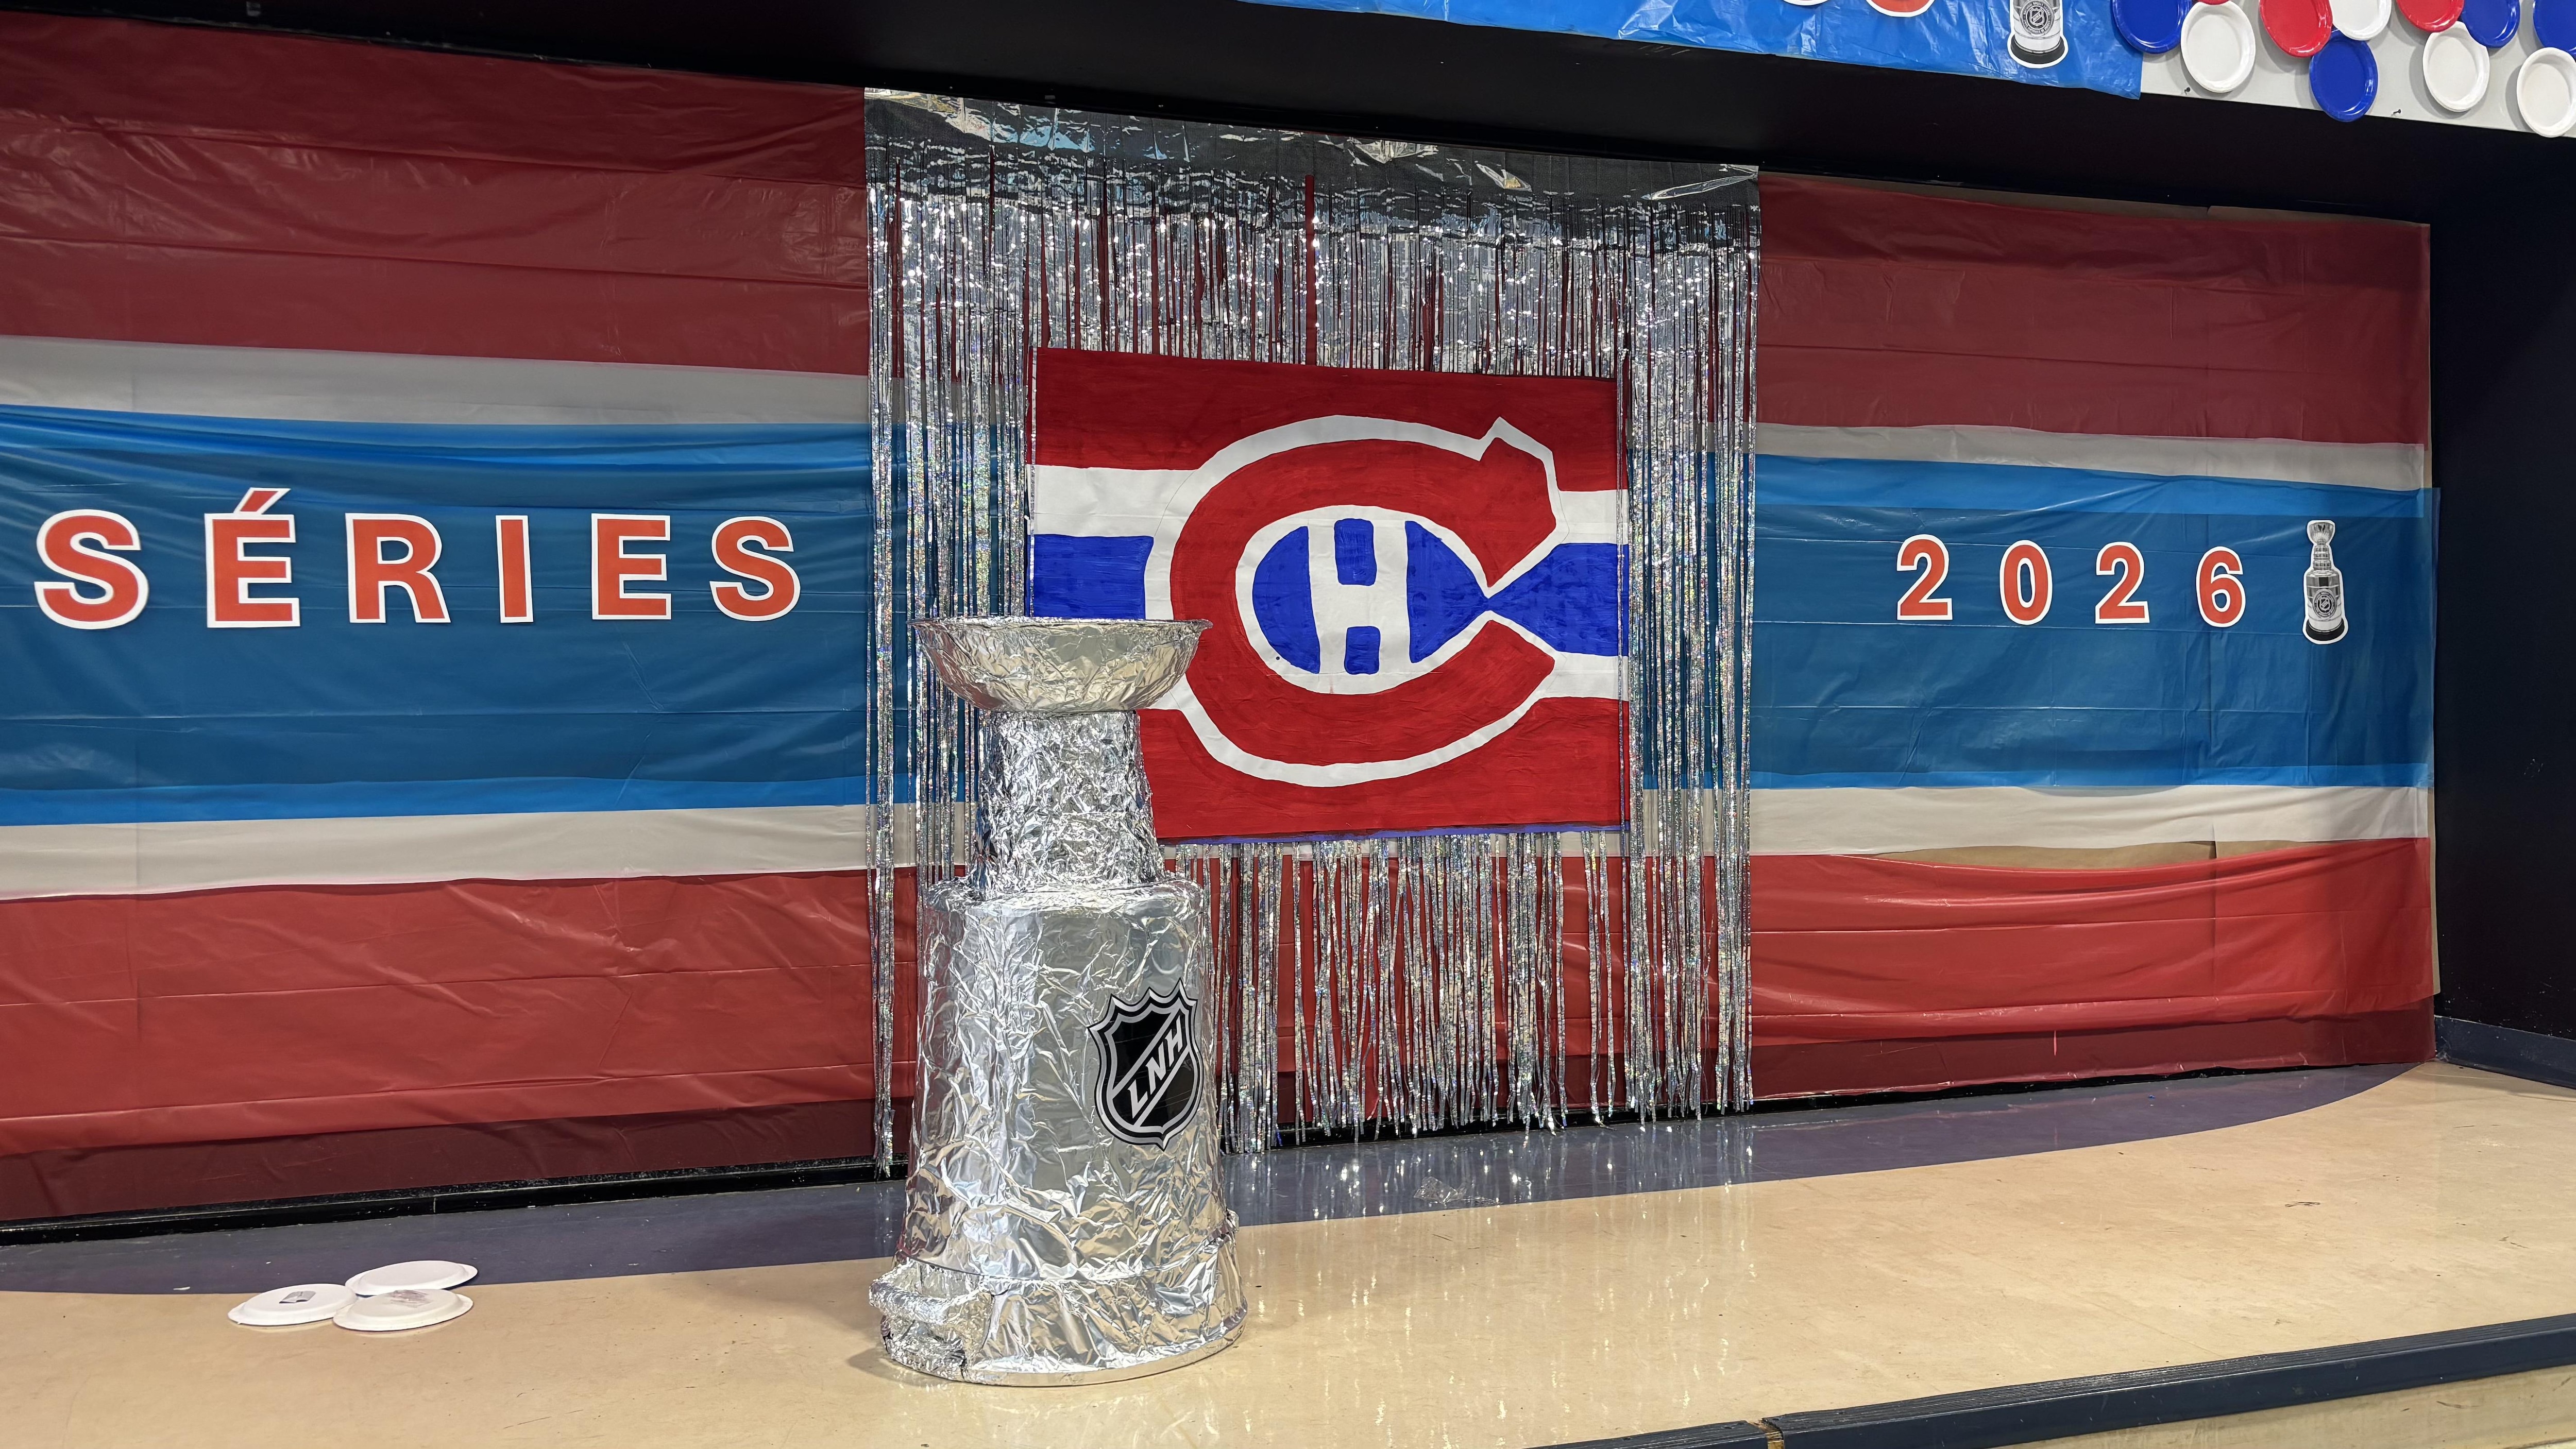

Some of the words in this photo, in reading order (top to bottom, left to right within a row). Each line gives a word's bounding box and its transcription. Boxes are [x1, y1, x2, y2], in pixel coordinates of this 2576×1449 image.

[33, 488, 801, 630] SÉRIES
[1896, 533, 2247, 627] 2026
[1127, 1015, 1183, 1119] LNH
